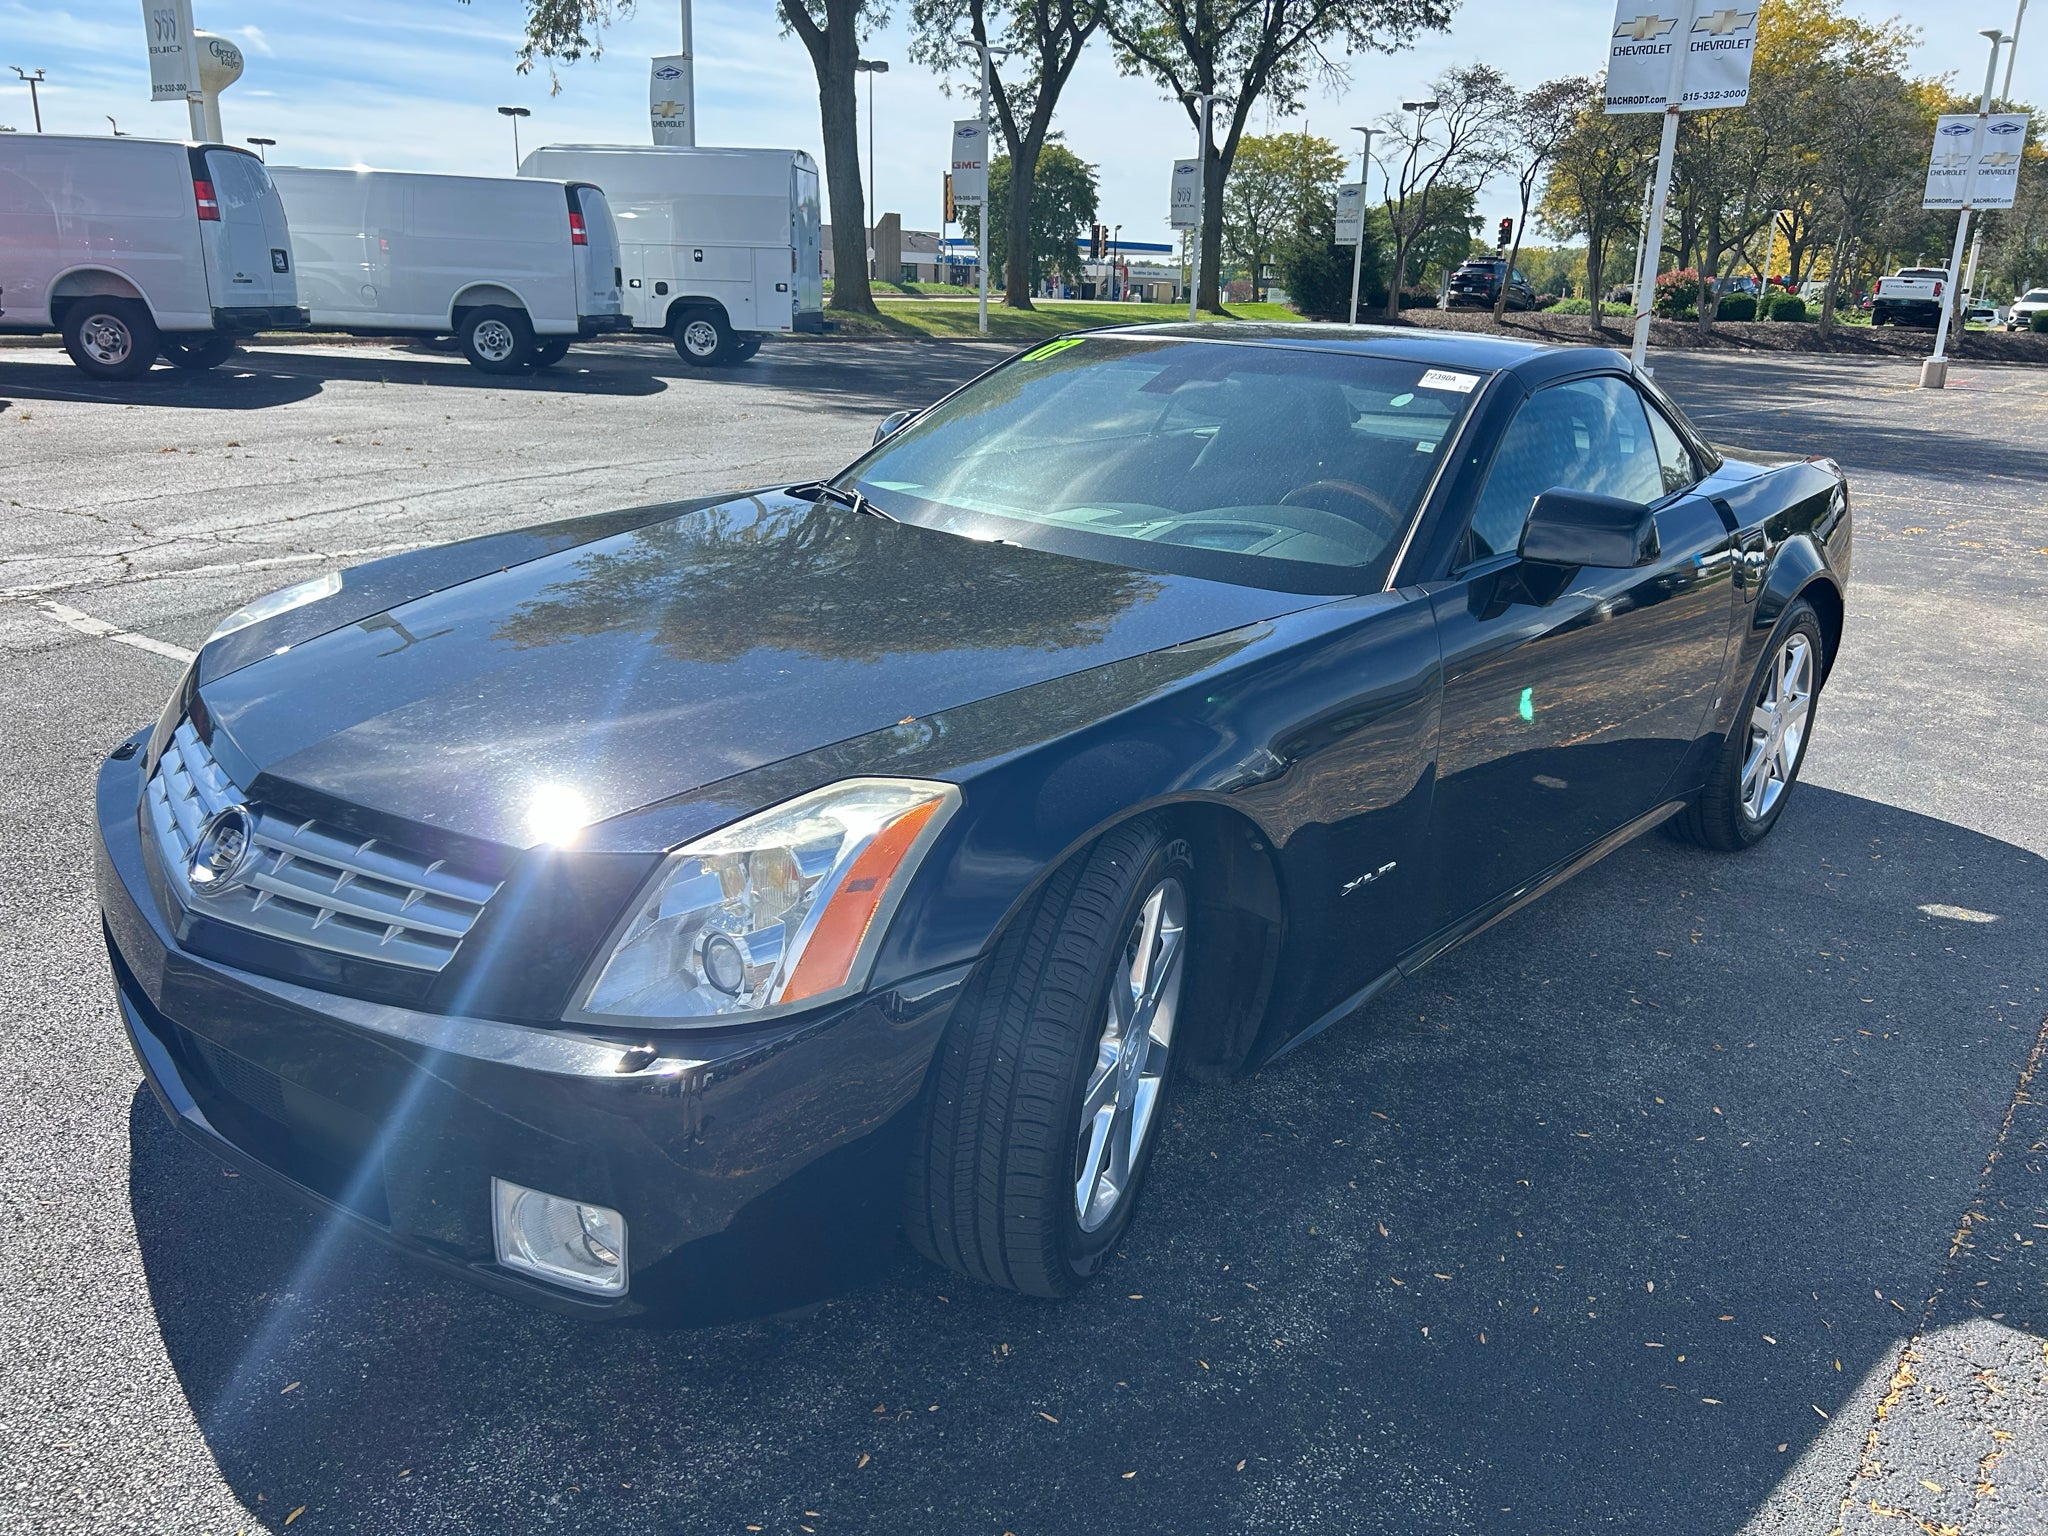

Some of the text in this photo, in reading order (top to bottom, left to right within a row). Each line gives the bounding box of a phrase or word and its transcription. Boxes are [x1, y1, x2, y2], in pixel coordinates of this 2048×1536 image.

[149, 45, 183, 54] BUICK
[1612, 43, 1673, 57] CHEVROLET
[1690, 38, 1752, 52] CHEVROLET
[1606, 95, 1667, 106] BACHRODT.com
[1682, 89, 1747, 102] 815-332-3000
[652, 120, 686, 128] CHEVROLET
[952, 161, 981, 170] GMC
[1978, 168, 2017, 176] CHEVROLET
